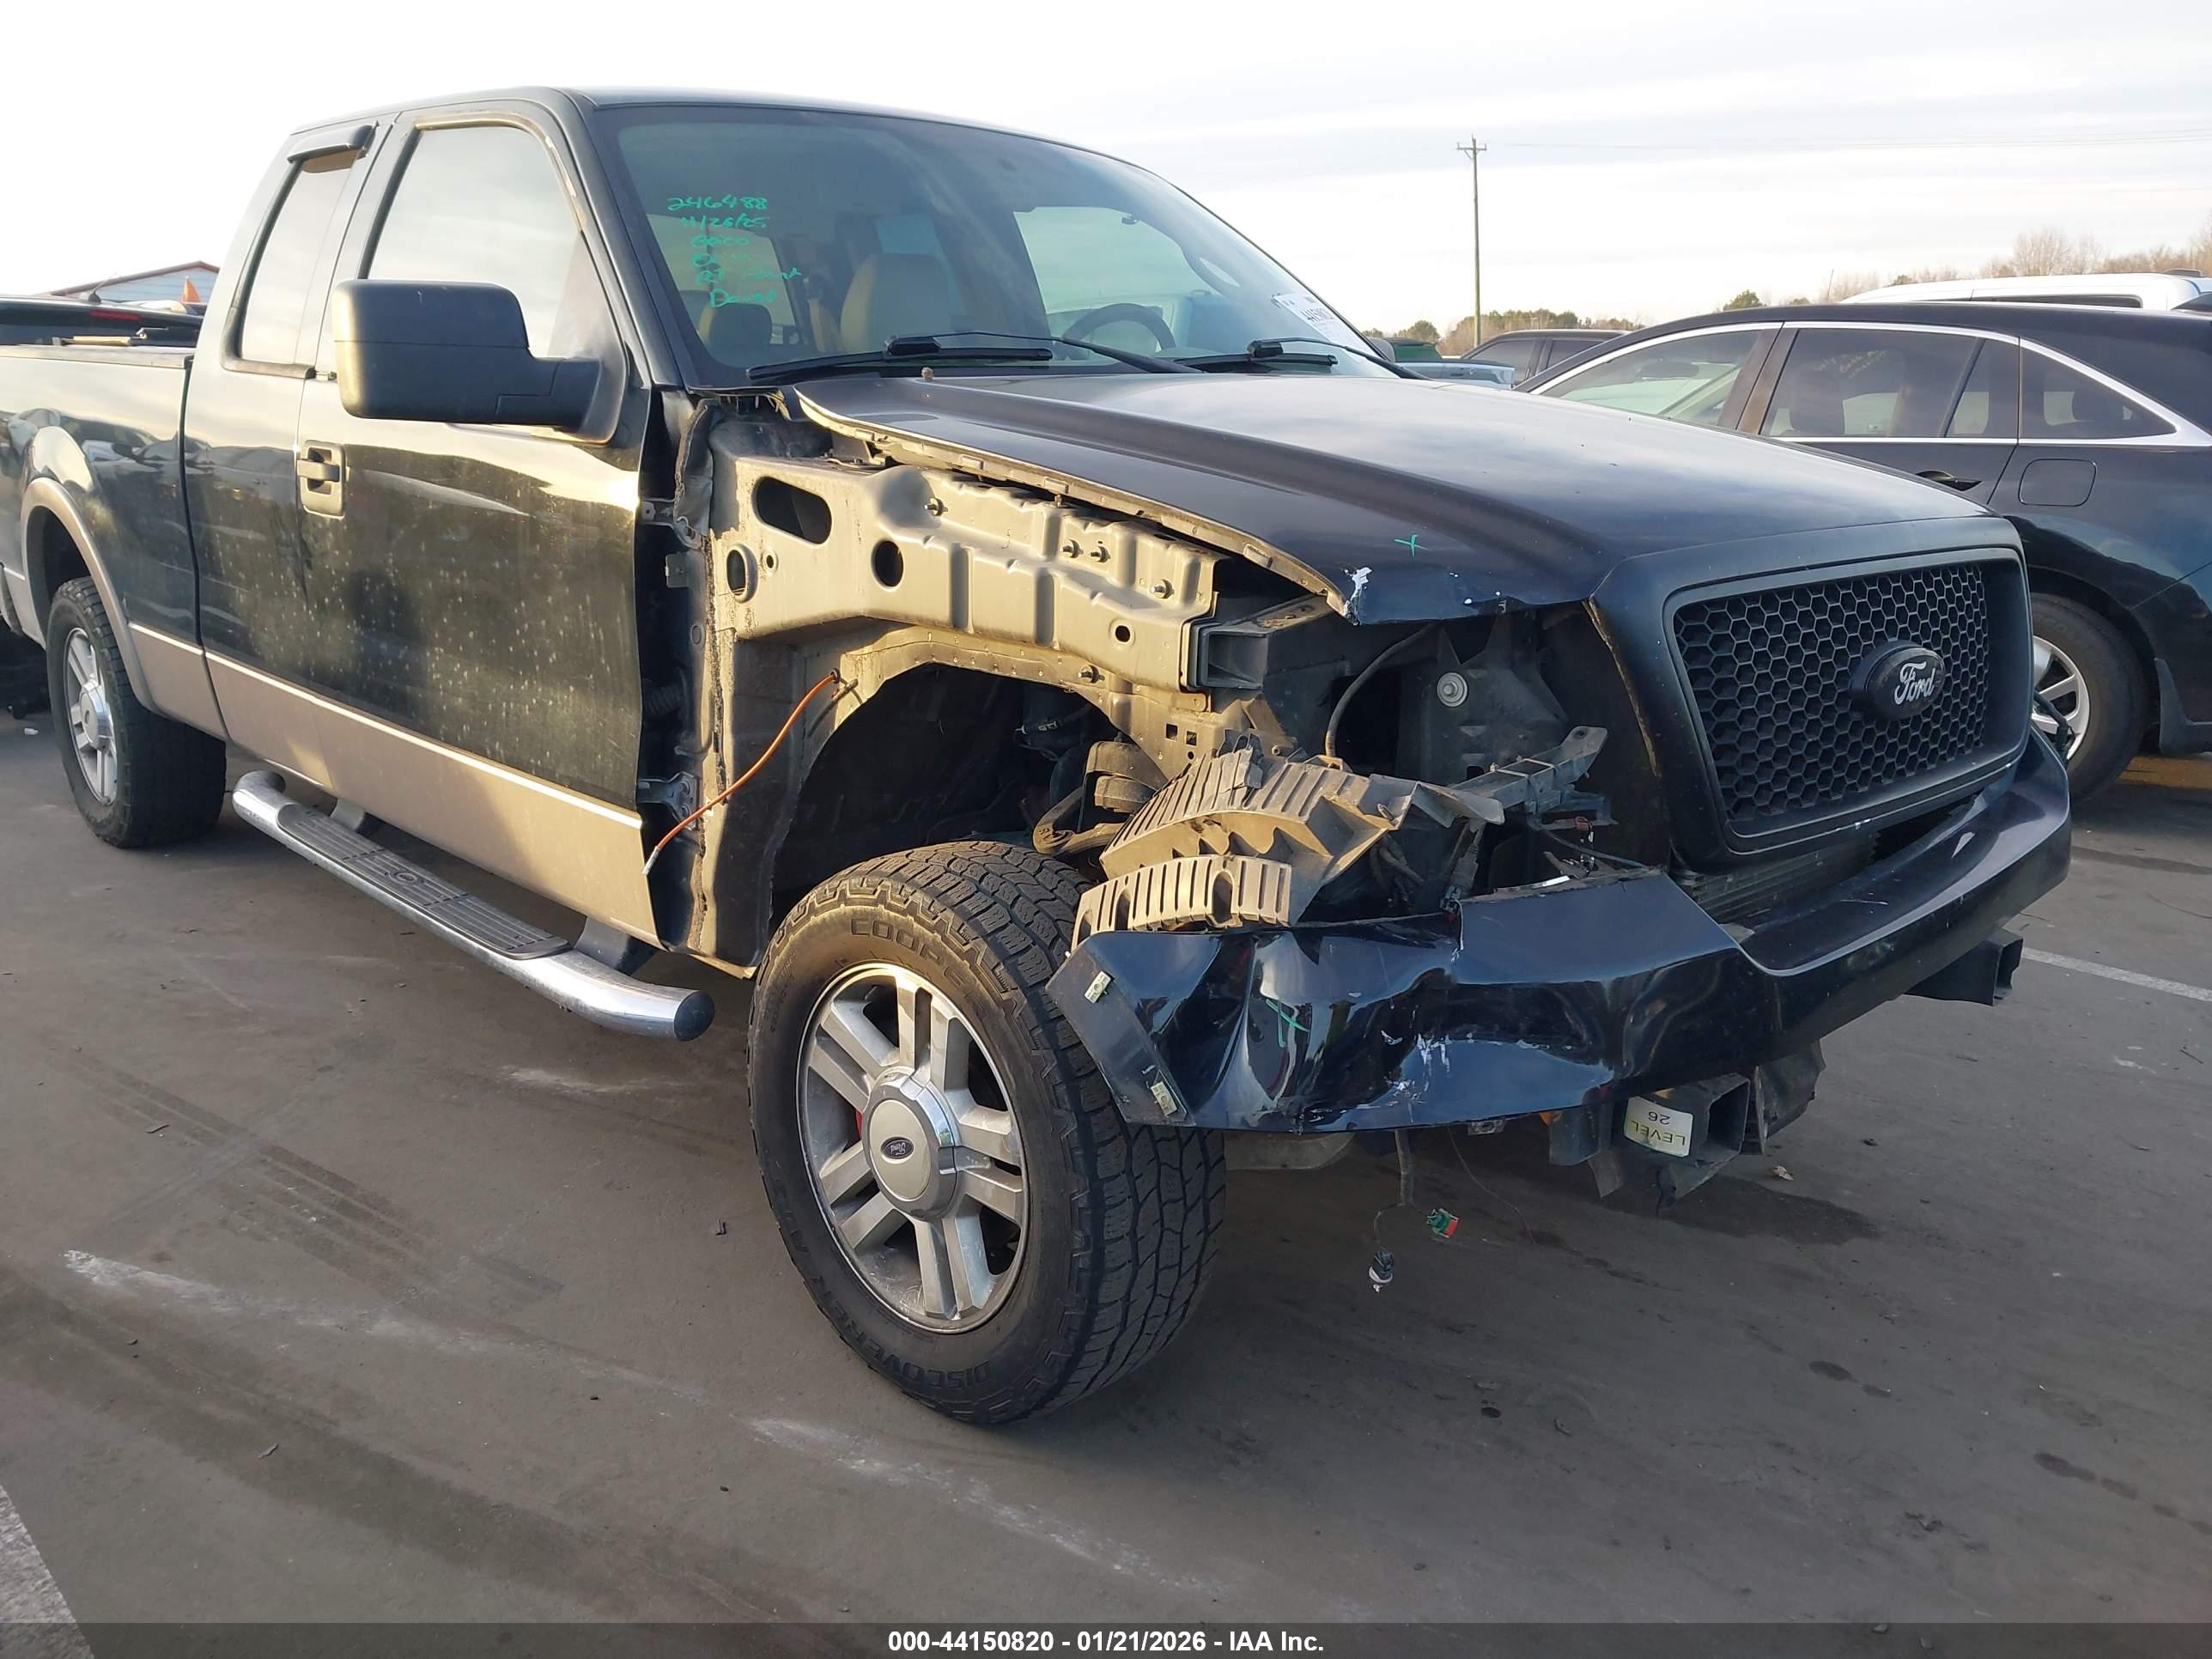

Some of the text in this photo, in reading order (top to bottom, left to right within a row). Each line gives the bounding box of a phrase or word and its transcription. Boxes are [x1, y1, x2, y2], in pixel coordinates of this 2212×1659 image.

[667, 194, 769, 211] 246488
[1894, 661, 1936, 705] Ford
[1648, 1111, 1671, 1126] 26
[1631, 1120, 1686, 1146] LEVEL
